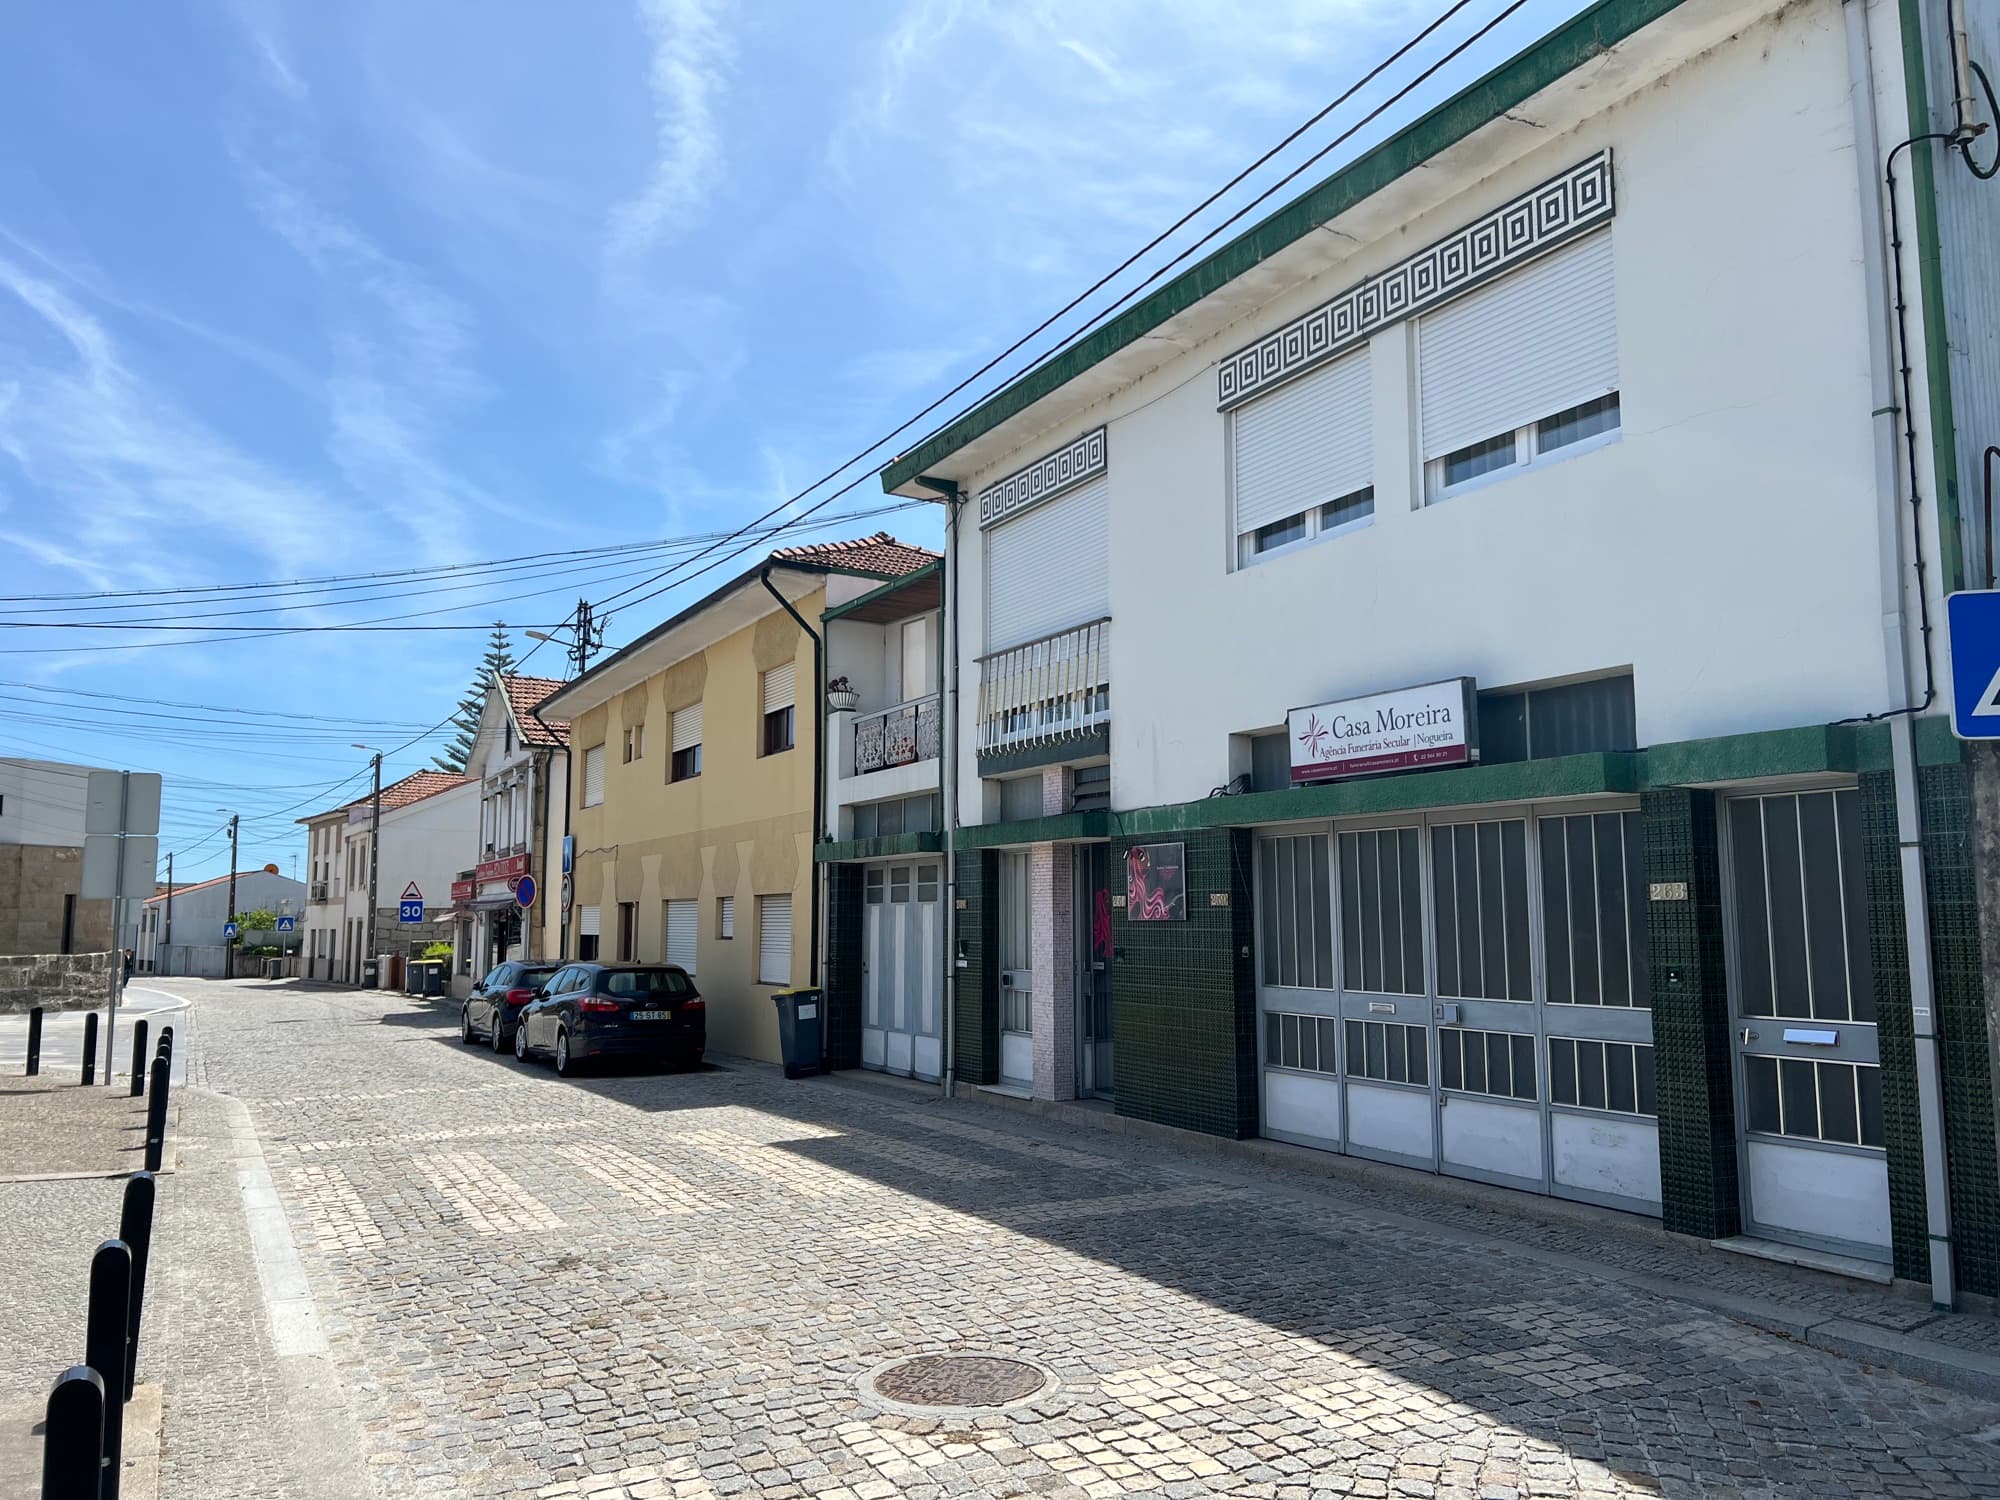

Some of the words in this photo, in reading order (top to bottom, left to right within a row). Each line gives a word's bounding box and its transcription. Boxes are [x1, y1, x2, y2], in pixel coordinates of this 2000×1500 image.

[1332, 715, 1370, 739] Casa
[1376, 704, 1451, 733] Moreira
[1319, 745, 1347, 761] Agência
[1348, 739, 1382, 754] Funerária
[1382, 735, 1410, 749] Secular
[1416, 730, 1454, 747] Nogueira
[402, 905, 421, 917] 30
